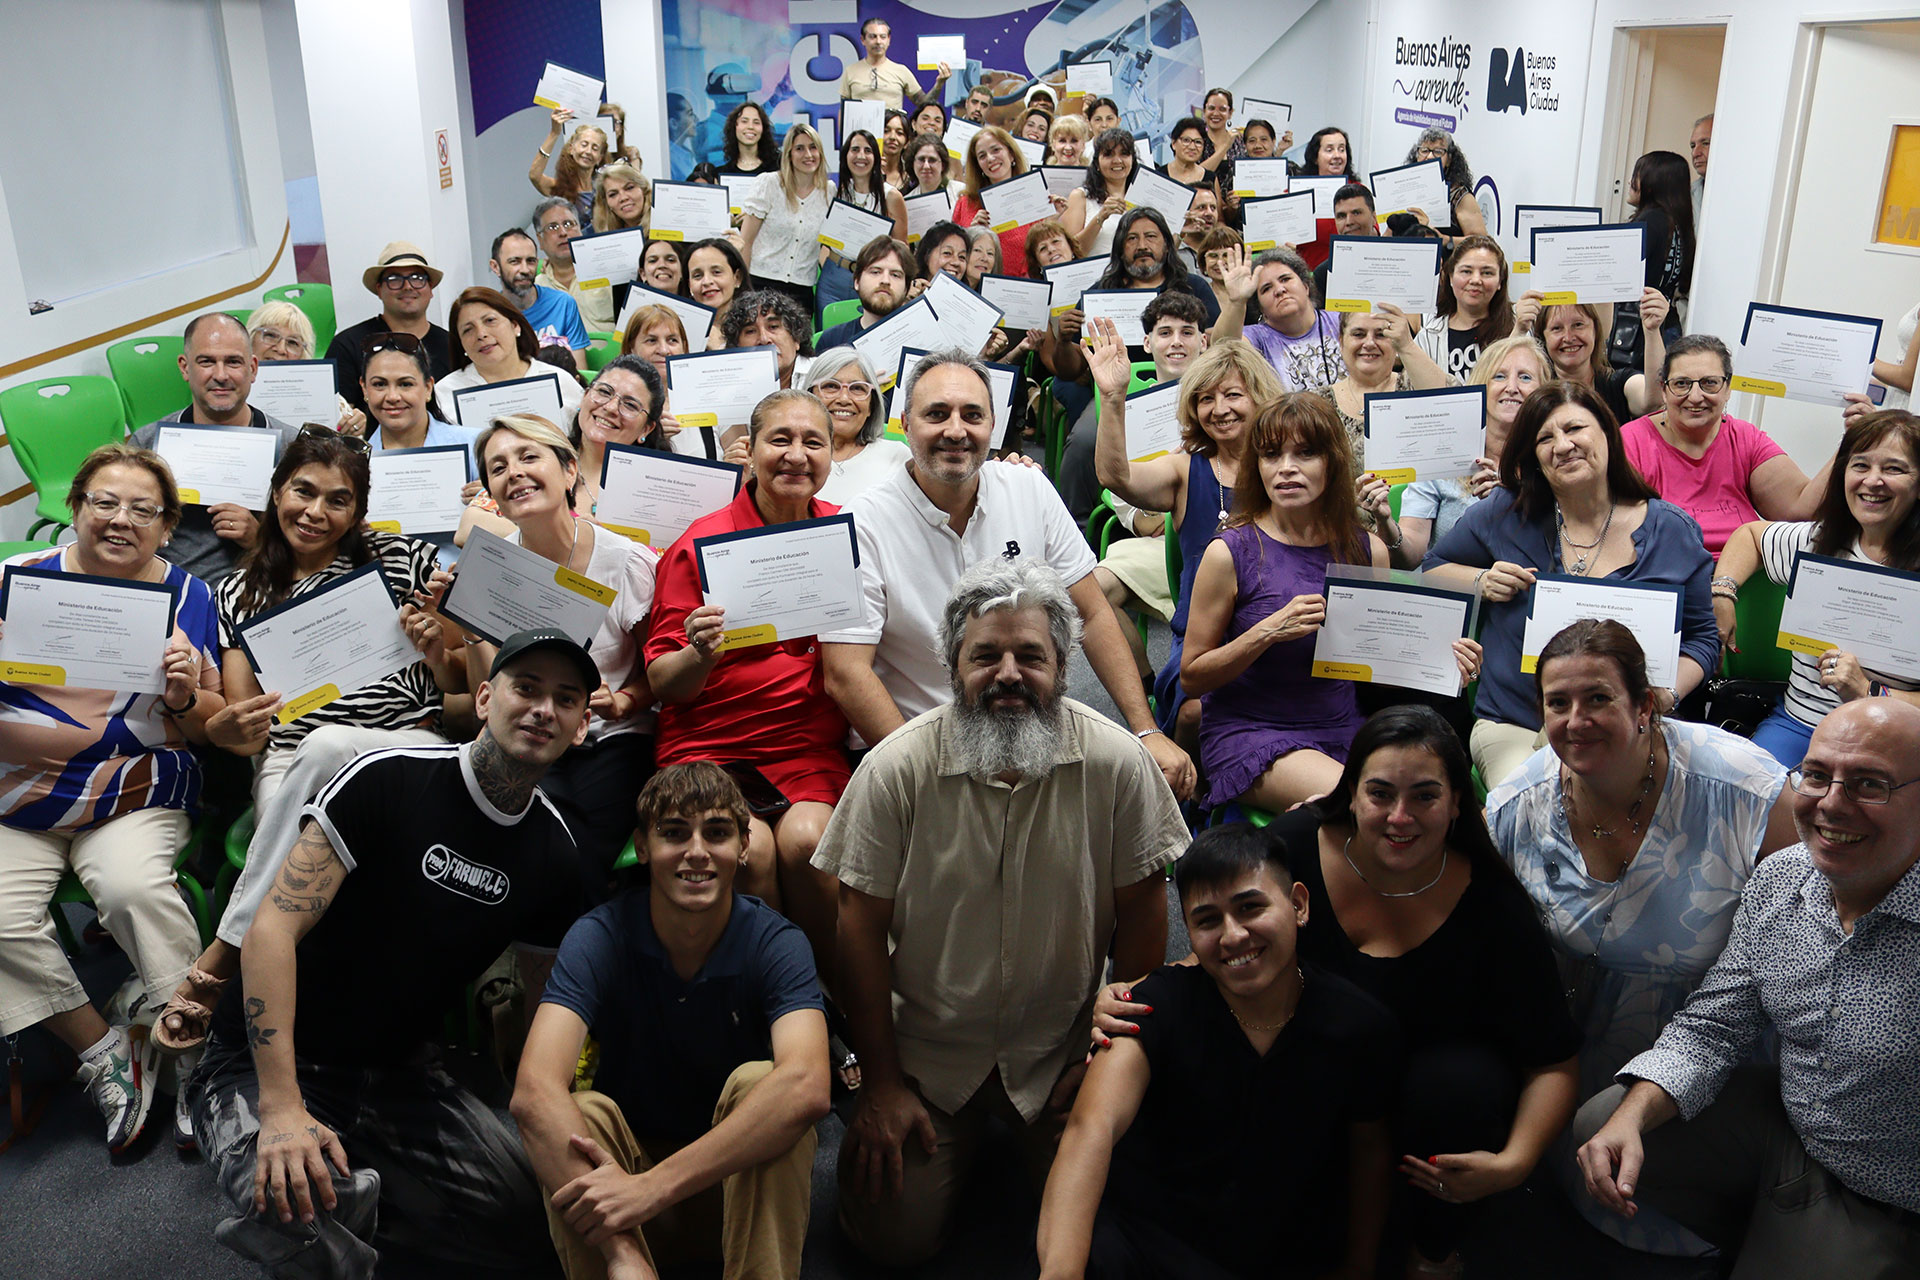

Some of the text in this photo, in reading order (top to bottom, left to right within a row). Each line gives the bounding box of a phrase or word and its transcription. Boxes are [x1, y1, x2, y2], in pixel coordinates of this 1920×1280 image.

[1396, 35, 1471, 70] Buenos Aires
[1527, 52, 1556, 70] Buenos
[1415, 54, 1465, 112] aprende
[1529, 72, 1551, 90] Aires
[1530, 92, 1560, 112] Ciudad
[750, 556, 775, 564] Ministerio
[783, 550, 809, 559] Educación
[1838, 586, 1862, 595] Ministerio
[1871, 592, 1897, 601] Educación
[95, 605, 122, 613] Educación
